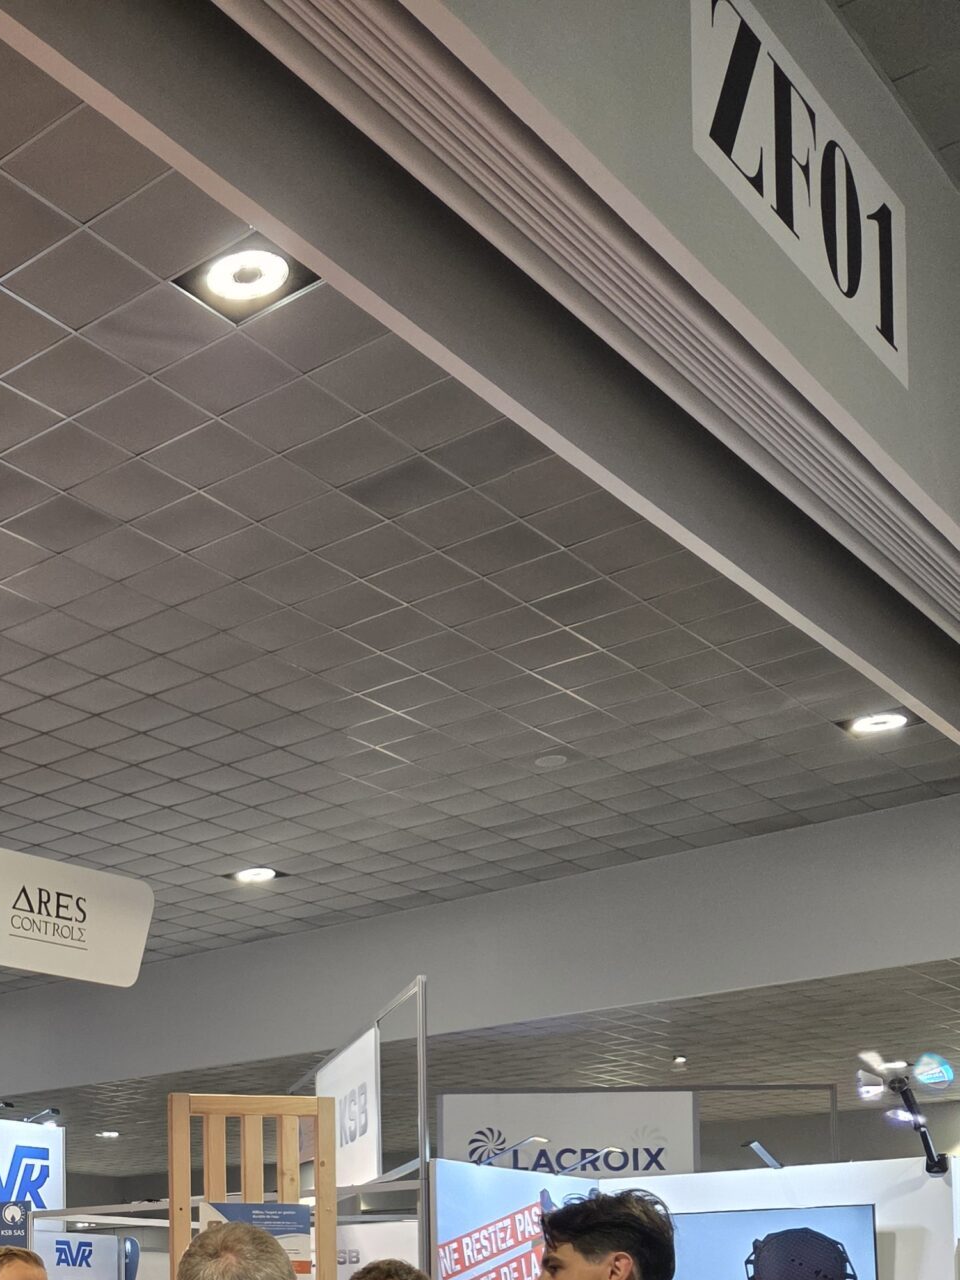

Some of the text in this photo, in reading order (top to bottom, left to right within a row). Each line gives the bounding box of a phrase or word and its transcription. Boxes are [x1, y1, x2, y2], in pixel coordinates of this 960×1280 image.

[709, 0, 899, 352] ZF01
[11, 885, 88, 923] ARES
[339, 1081, 368, 1149] KSB
[512, 1147, 667, 1173] LACROIX
[55, 1239, 93, 1268] AVK
[438, 1206, 542, 1279] NE RESTEZ PAS
